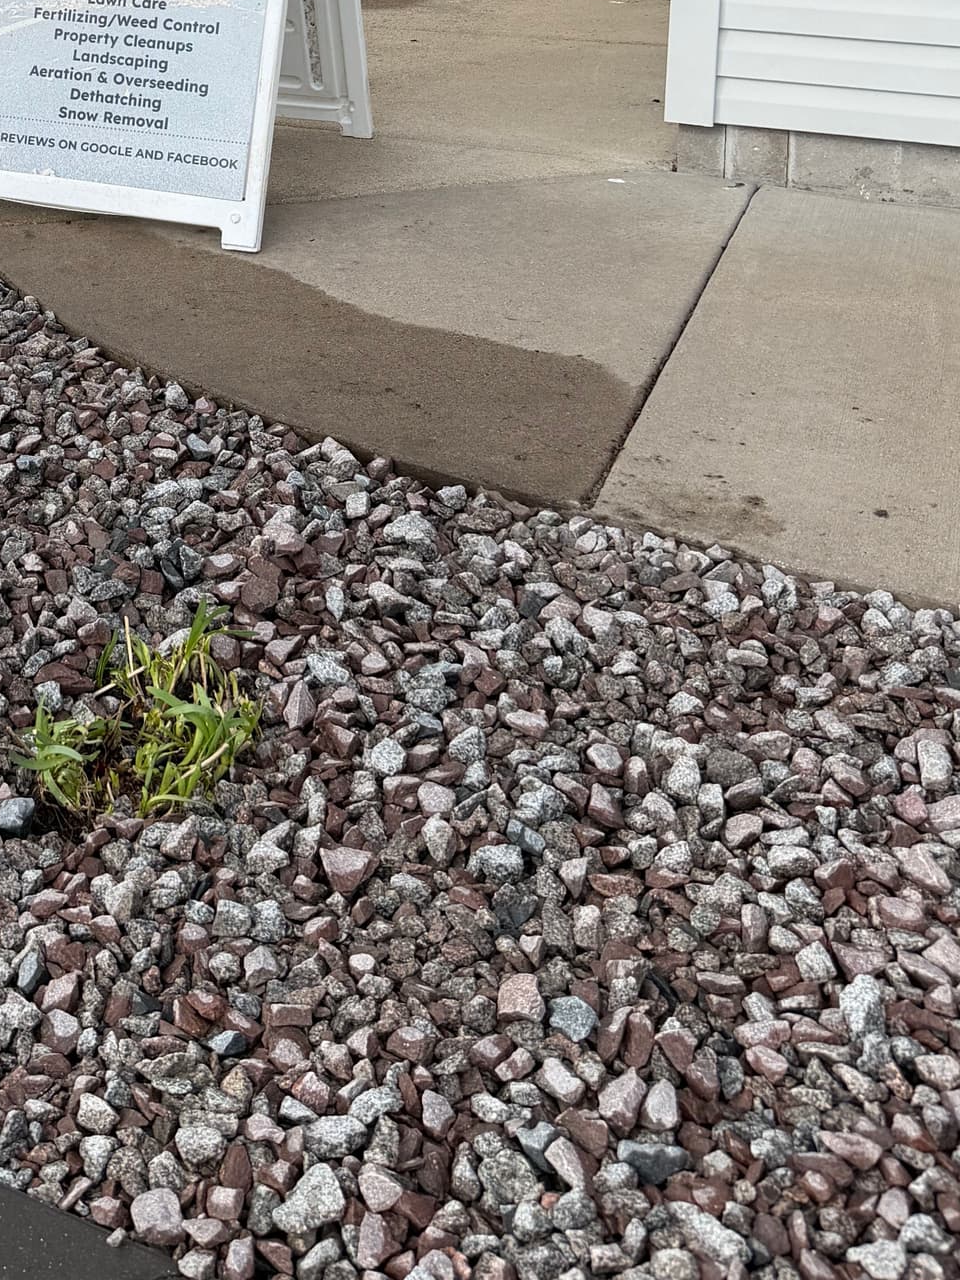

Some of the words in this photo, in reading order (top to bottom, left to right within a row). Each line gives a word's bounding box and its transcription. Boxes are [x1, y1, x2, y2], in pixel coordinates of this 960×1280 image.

[33, 7, 158, 29] Fertilizing/Weed
[163, 18, 220, 35] Control
[54, 28, 119, 48] Property
[123, 34, 193, 55] Cleanups
[73, 49, 169, 72] Landscaping
[29, 65, 92, 82] Aeration
[97, 71, 108, 84] &
[113, 72, 209, 97] Overseeding
[70, 88, 162, 112] Dethatching
[58, 106, 98, 122] Snow
[103, 111, 169, 130] Removal
[0, 132, 56, 148] REVIEWS
[58, 139, 77, 151] ON
[80, 141, 133, 157] GOOGLE
[135, 148, 164, 161] AND
[167, 152, 239, 169] FACEBOOK
